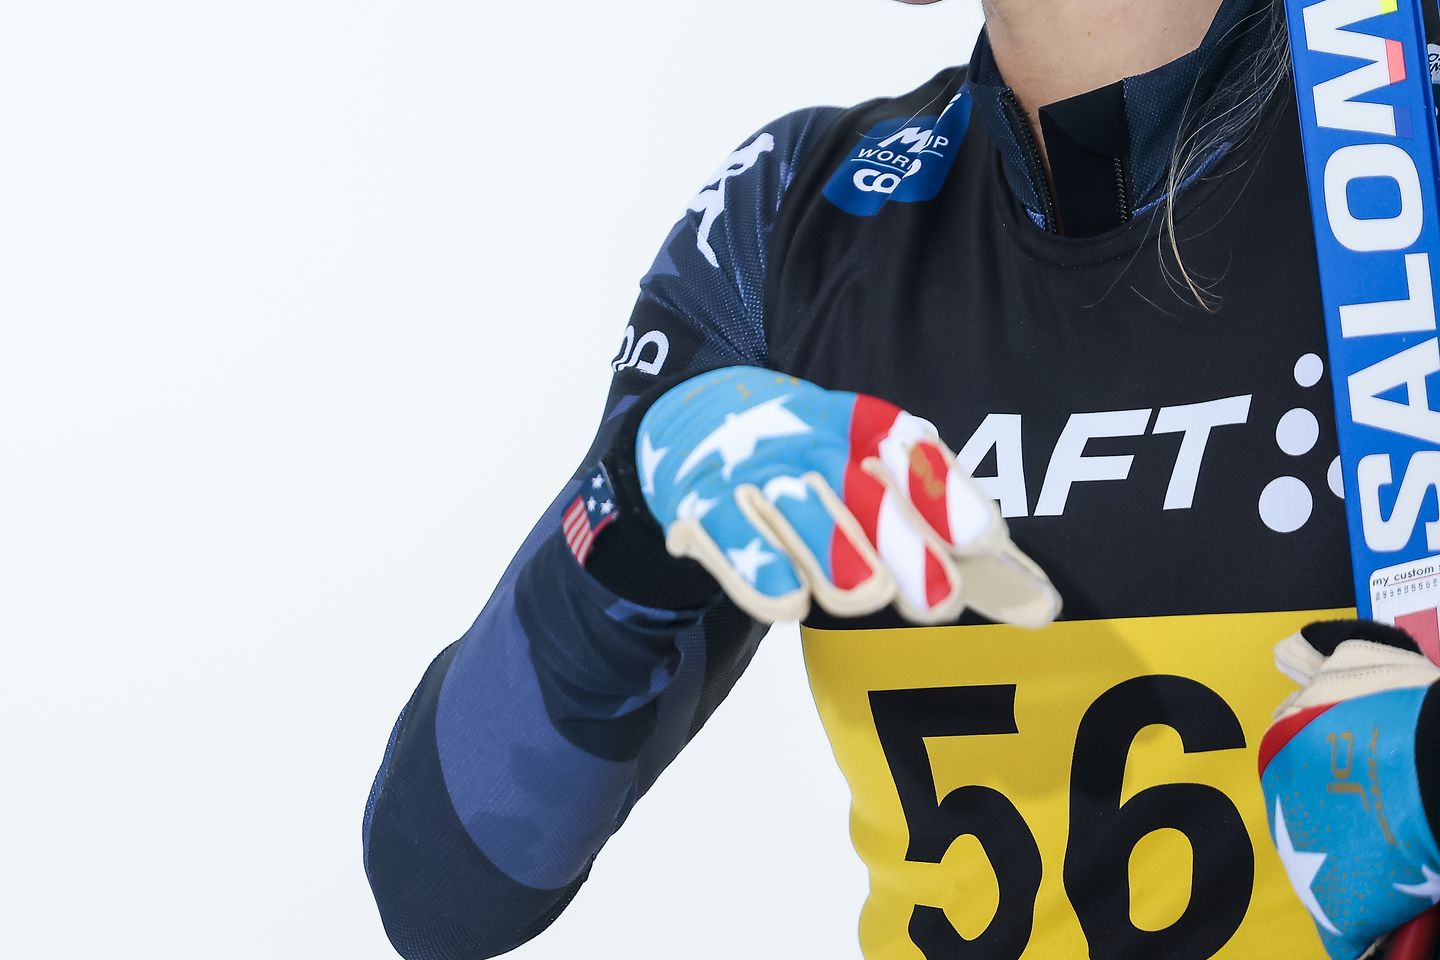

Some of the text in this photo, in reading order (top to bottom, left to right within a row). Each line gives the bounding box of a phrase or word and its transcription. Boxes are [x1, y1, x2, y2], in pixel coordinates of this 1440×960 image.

[858, 148, 913, 170] WOR
[930, 393, 1253, 519] AFT
[1372, 565, 1435, 588] my custom
[867, 673, 1256, 960] 56
